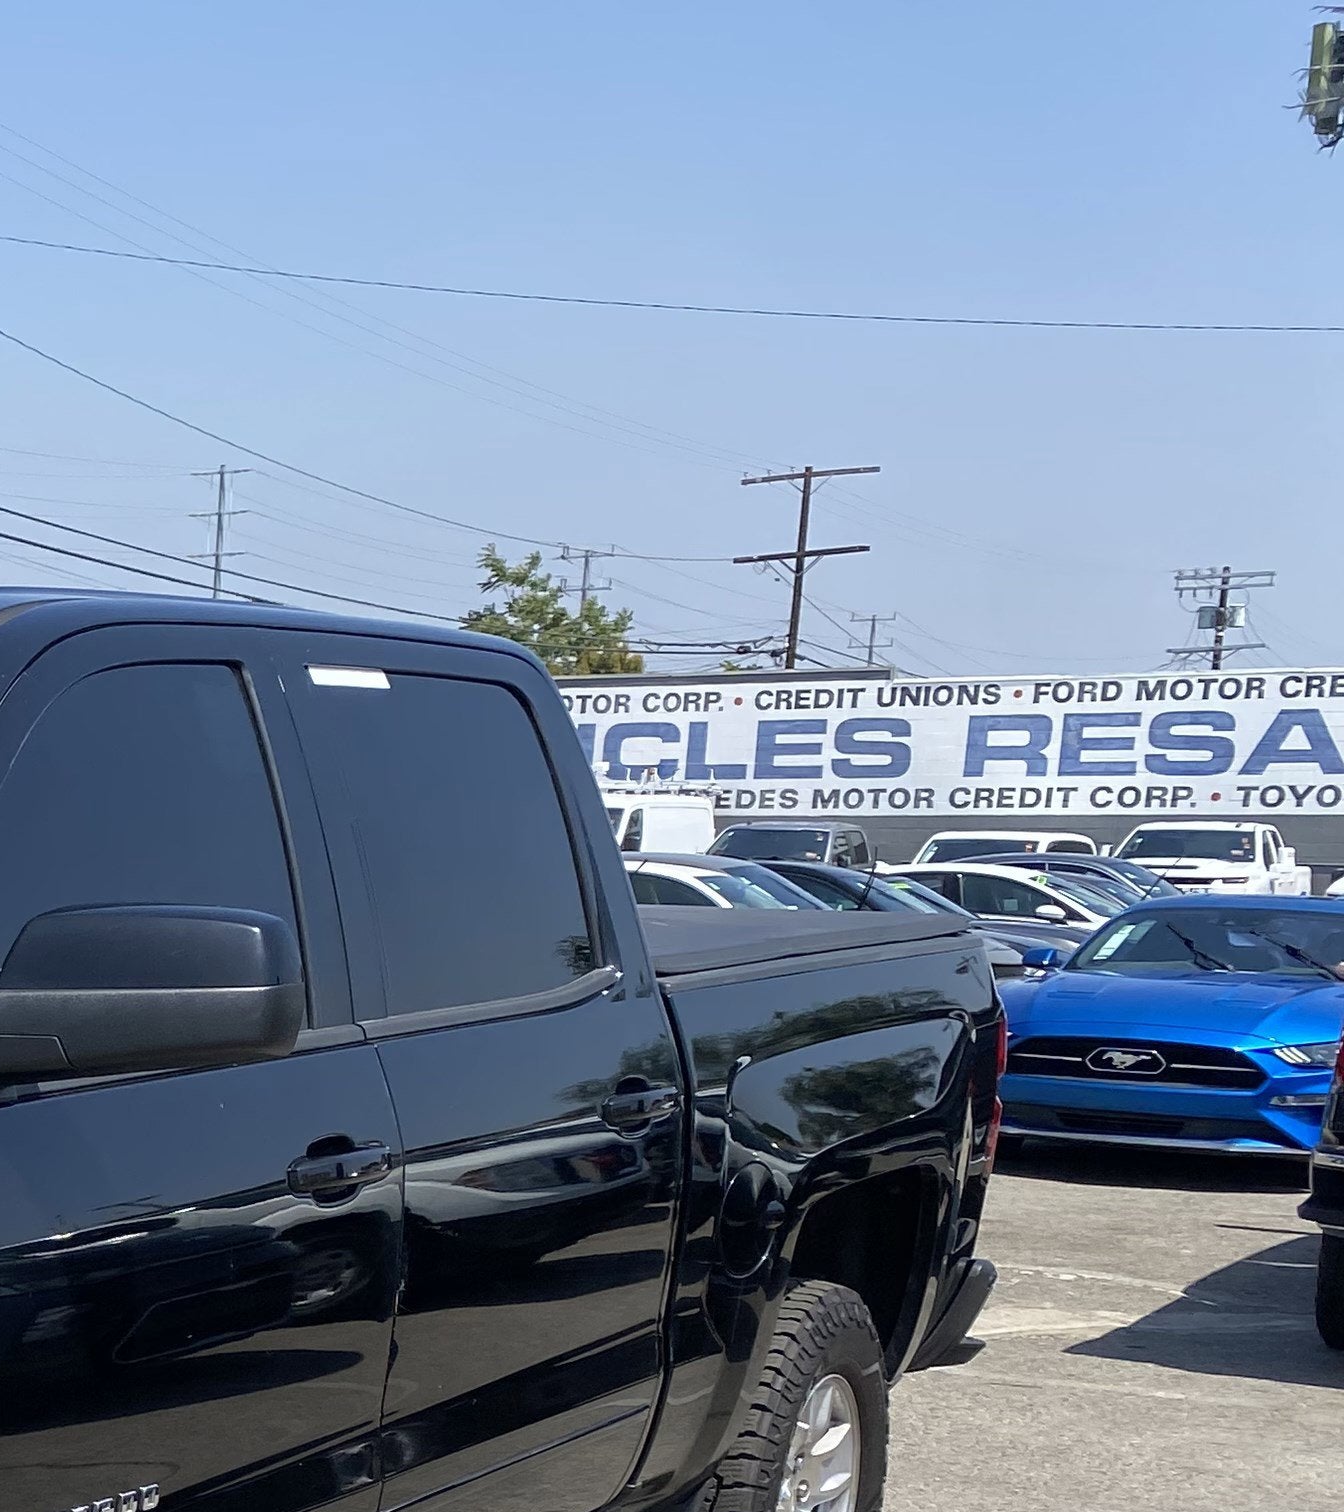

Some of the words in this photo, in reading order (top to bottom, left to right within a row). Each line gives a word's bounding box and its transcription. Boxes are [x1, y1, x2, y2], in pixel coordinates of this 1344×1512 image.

[642, 691, 723, 713] CORP.
[755, 687, 866, 711] CREDIT
[877, 683, 1002, 708] UNIONS
[1032, 680, 1123, 704] FORD
[1135, 676, 1266, 701] MOTOR
[964, 708, 1344, 778] RESA
[812, 787, 935, 810] MOTOR
[948, 786, 1079, 809] CREDIT
[1090, 785, 1197, 809] CORP.
[1236, 784, 1342, 808] TOYO
